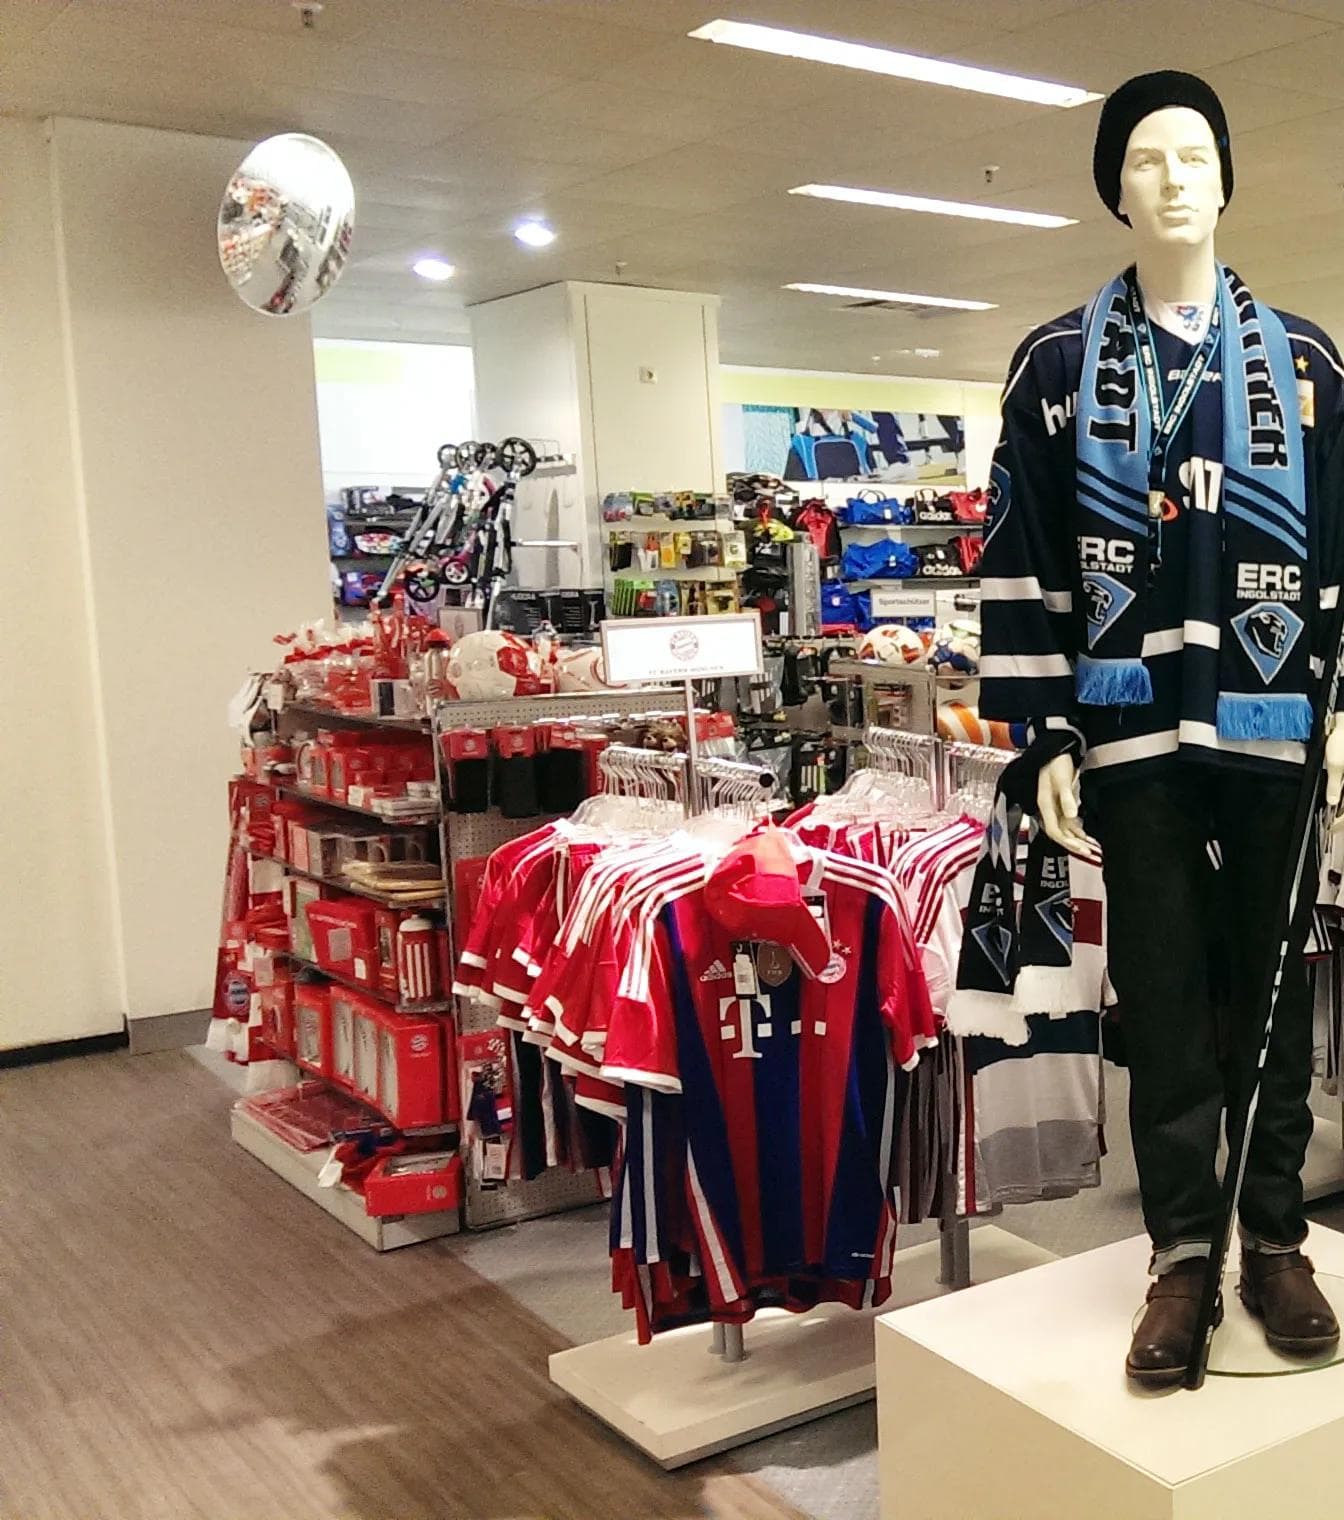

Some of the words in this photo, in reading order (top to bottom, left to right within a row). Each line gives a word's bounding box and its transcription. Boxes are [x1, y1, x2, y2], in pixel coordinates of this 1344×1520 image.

[1077, 536, 1136, 564] RC
[1236, 562, 1302, 591] ERC
[1236, 589, 1302, 602] INGOLSTADT
